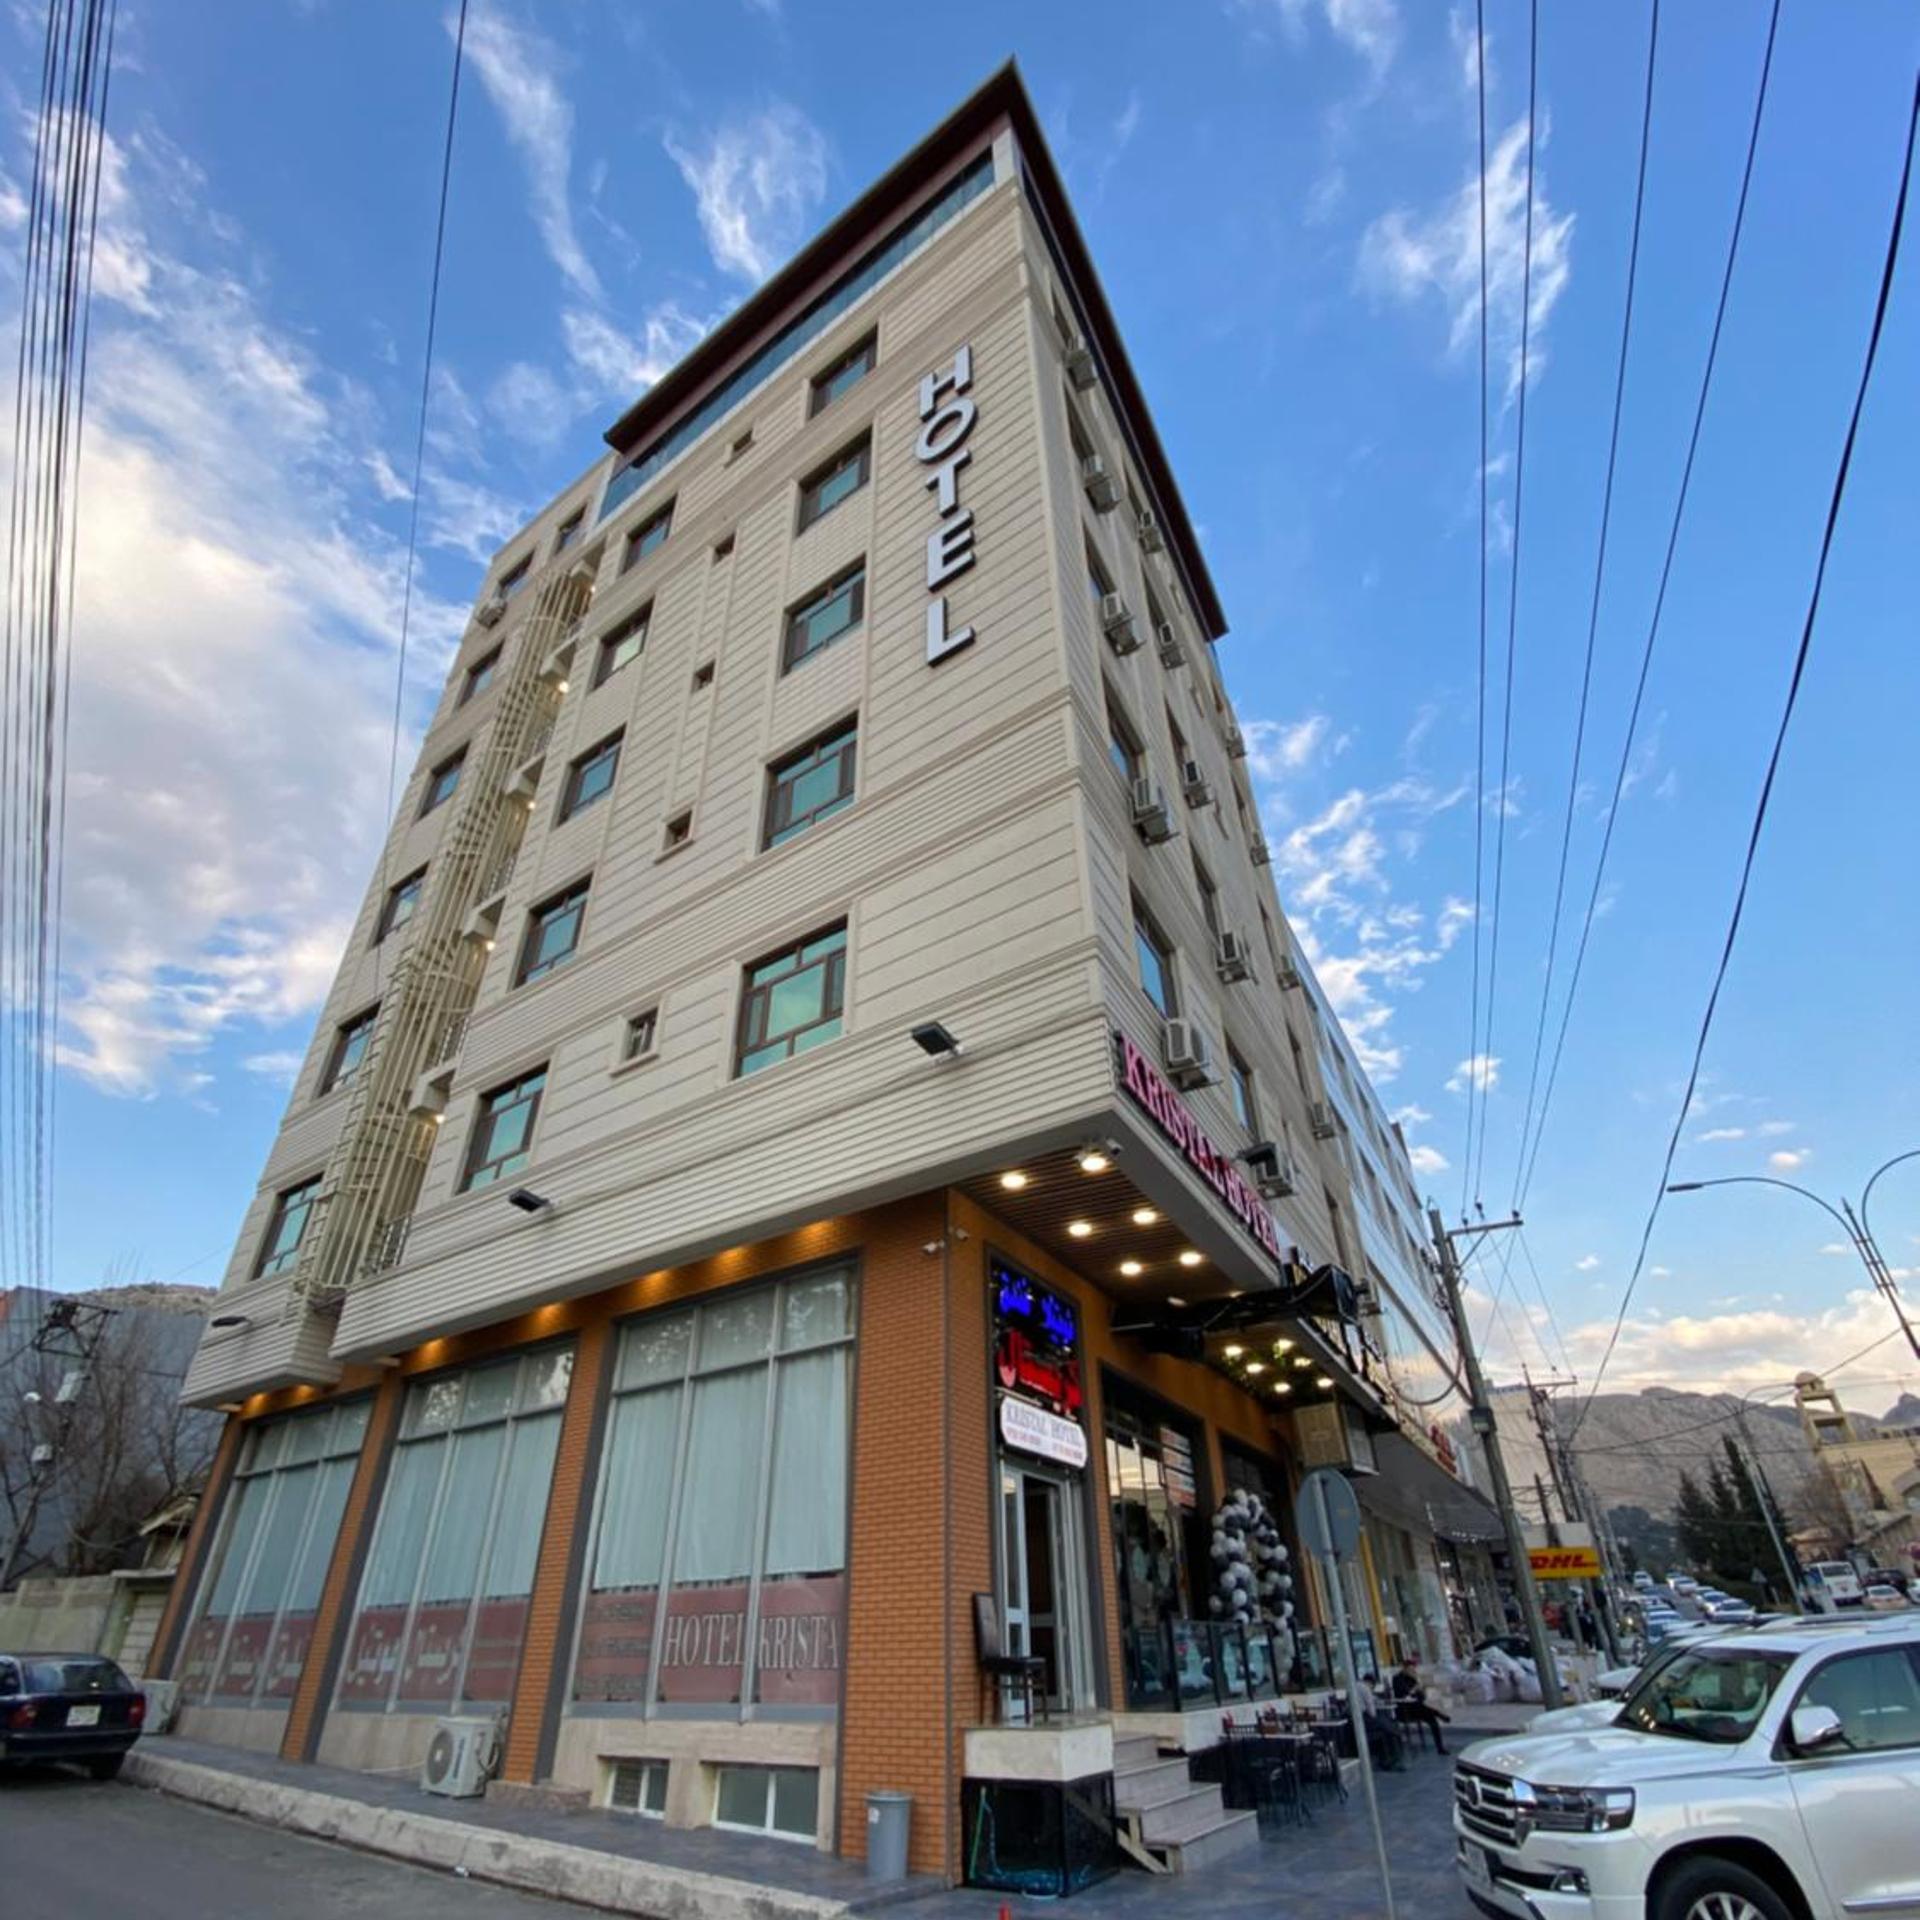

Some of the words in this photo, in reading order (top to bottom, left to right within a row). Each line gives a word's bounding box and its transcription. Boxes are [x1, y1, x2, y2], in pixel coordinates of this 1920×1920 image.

[915, 345, 976, 668] HOTEL
[1223, 1162, 1281, 1260] HOTEL
[1530, 1553, 1584, 1569] DHL
[663, 1613, 745, 1667] HOTEL
